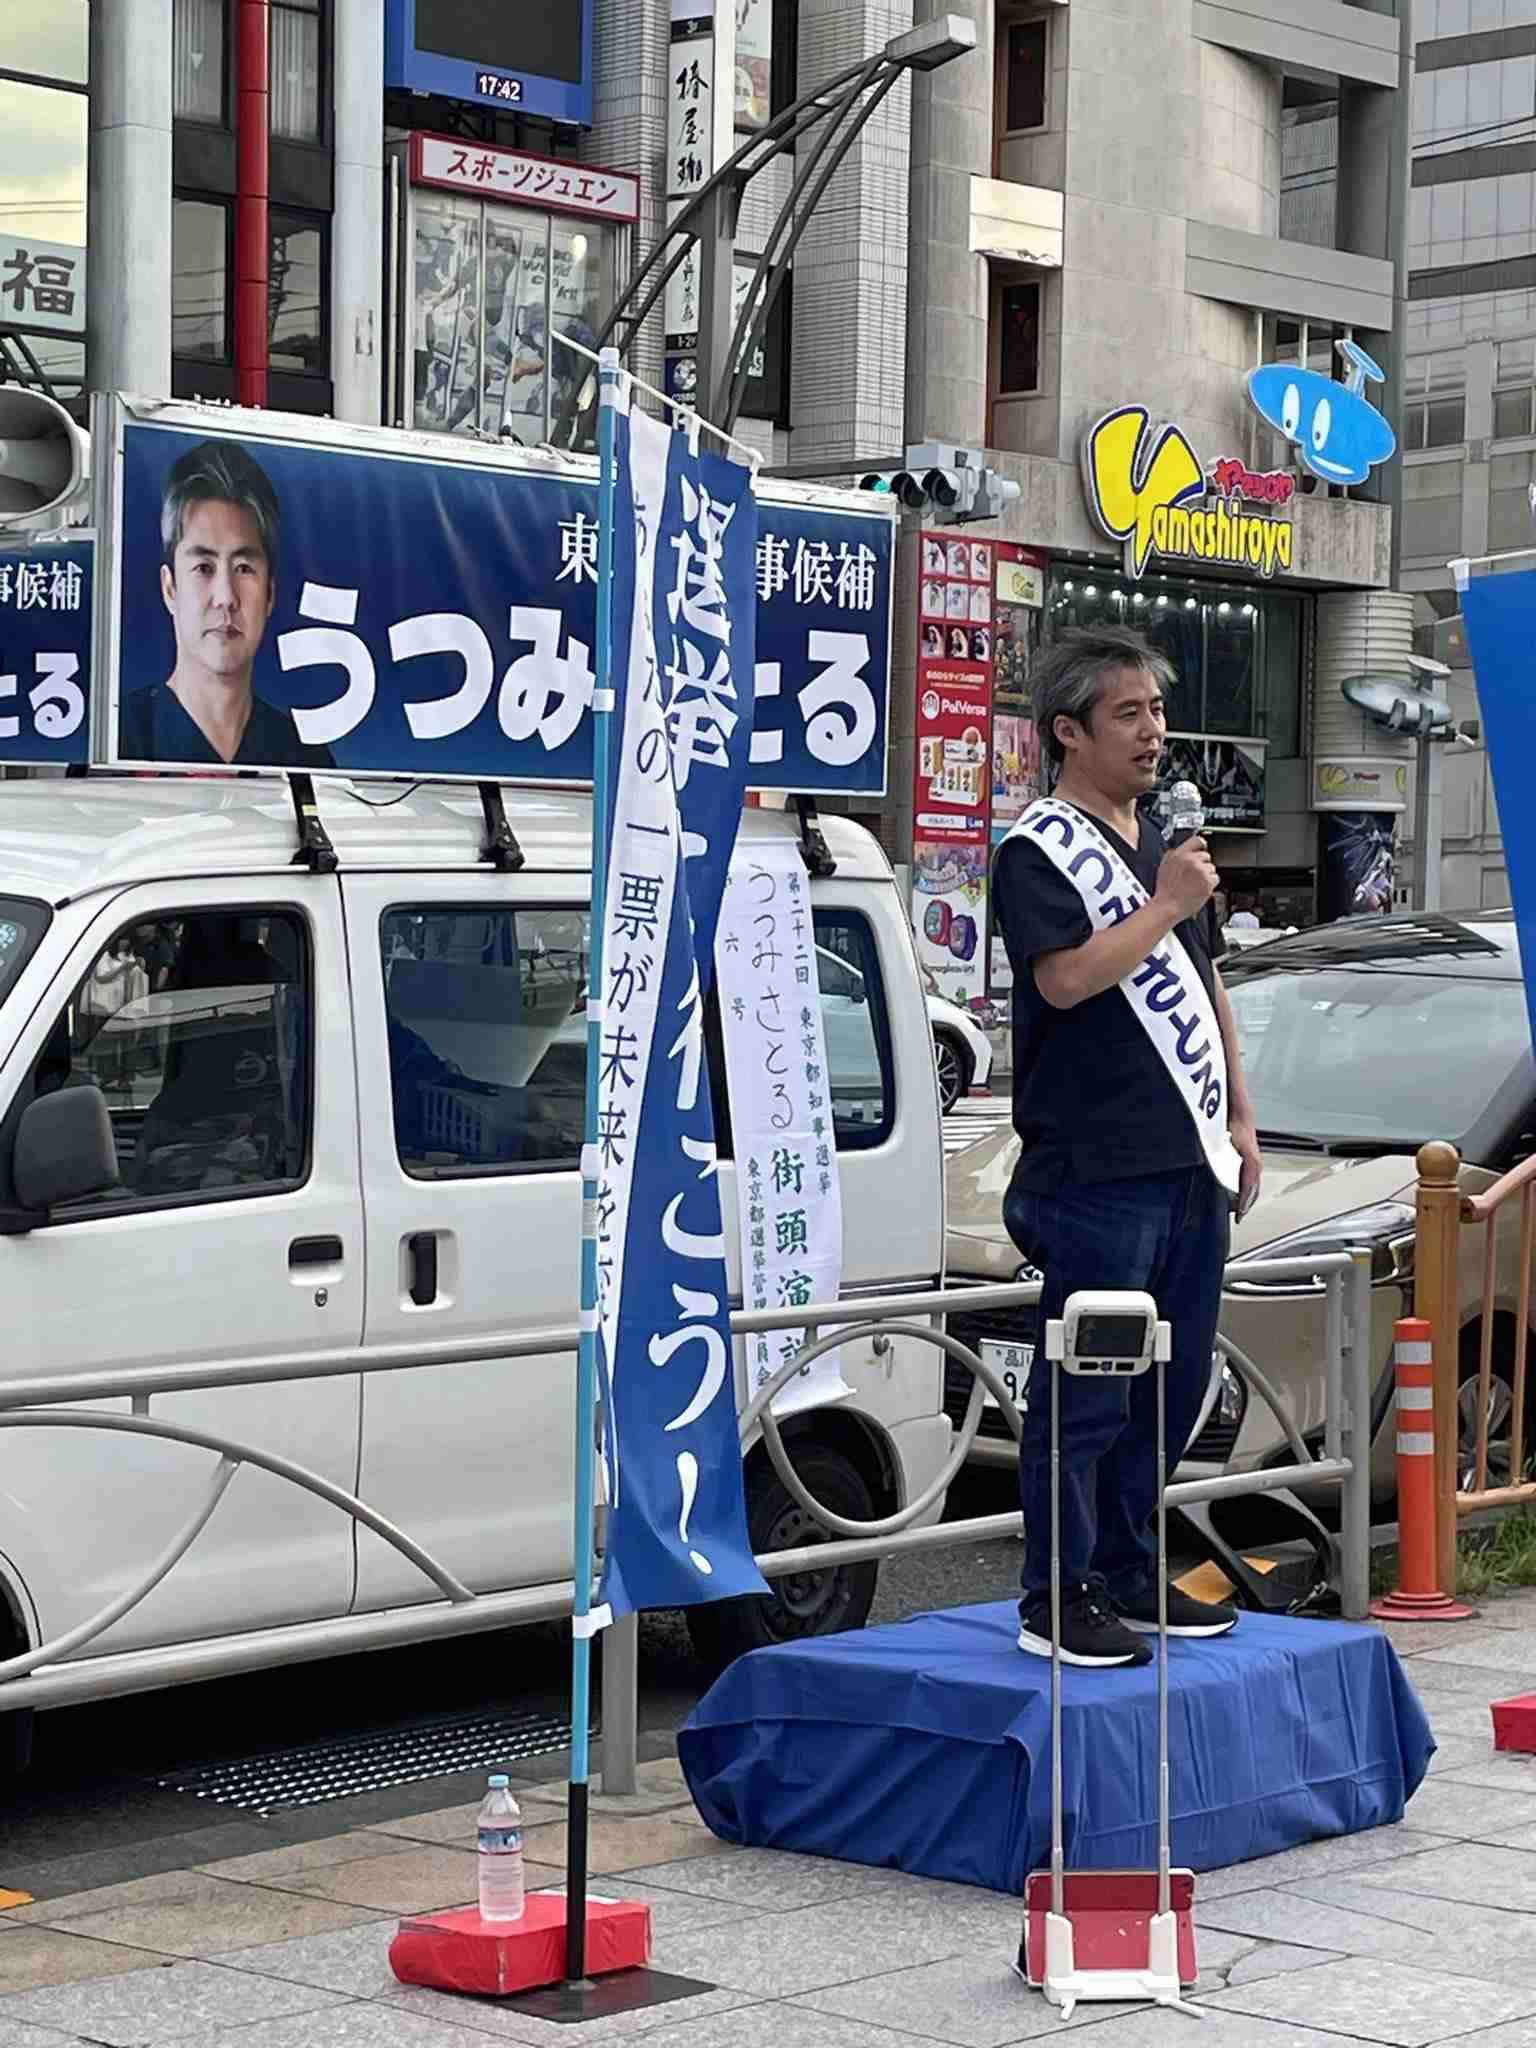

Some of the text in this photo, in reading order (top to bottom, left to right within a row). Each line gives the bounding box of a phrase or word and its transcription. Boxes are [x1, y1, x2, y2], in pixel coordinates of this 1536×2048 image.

[478, 75, 521, 101] 17:42
[447, 149, 617, 205] スポーツジュエン
[2, 248, 75, 315] 福
[1088, 405, 1293, 579] Yamashiroya
[0, 561, 84, 611] 候補
[276, 580, 877, 768] うつみる
[749, 862, 794, 1130] うつみさとる
[748, 1156, 771, 1387] 東京都選挙管理員会
